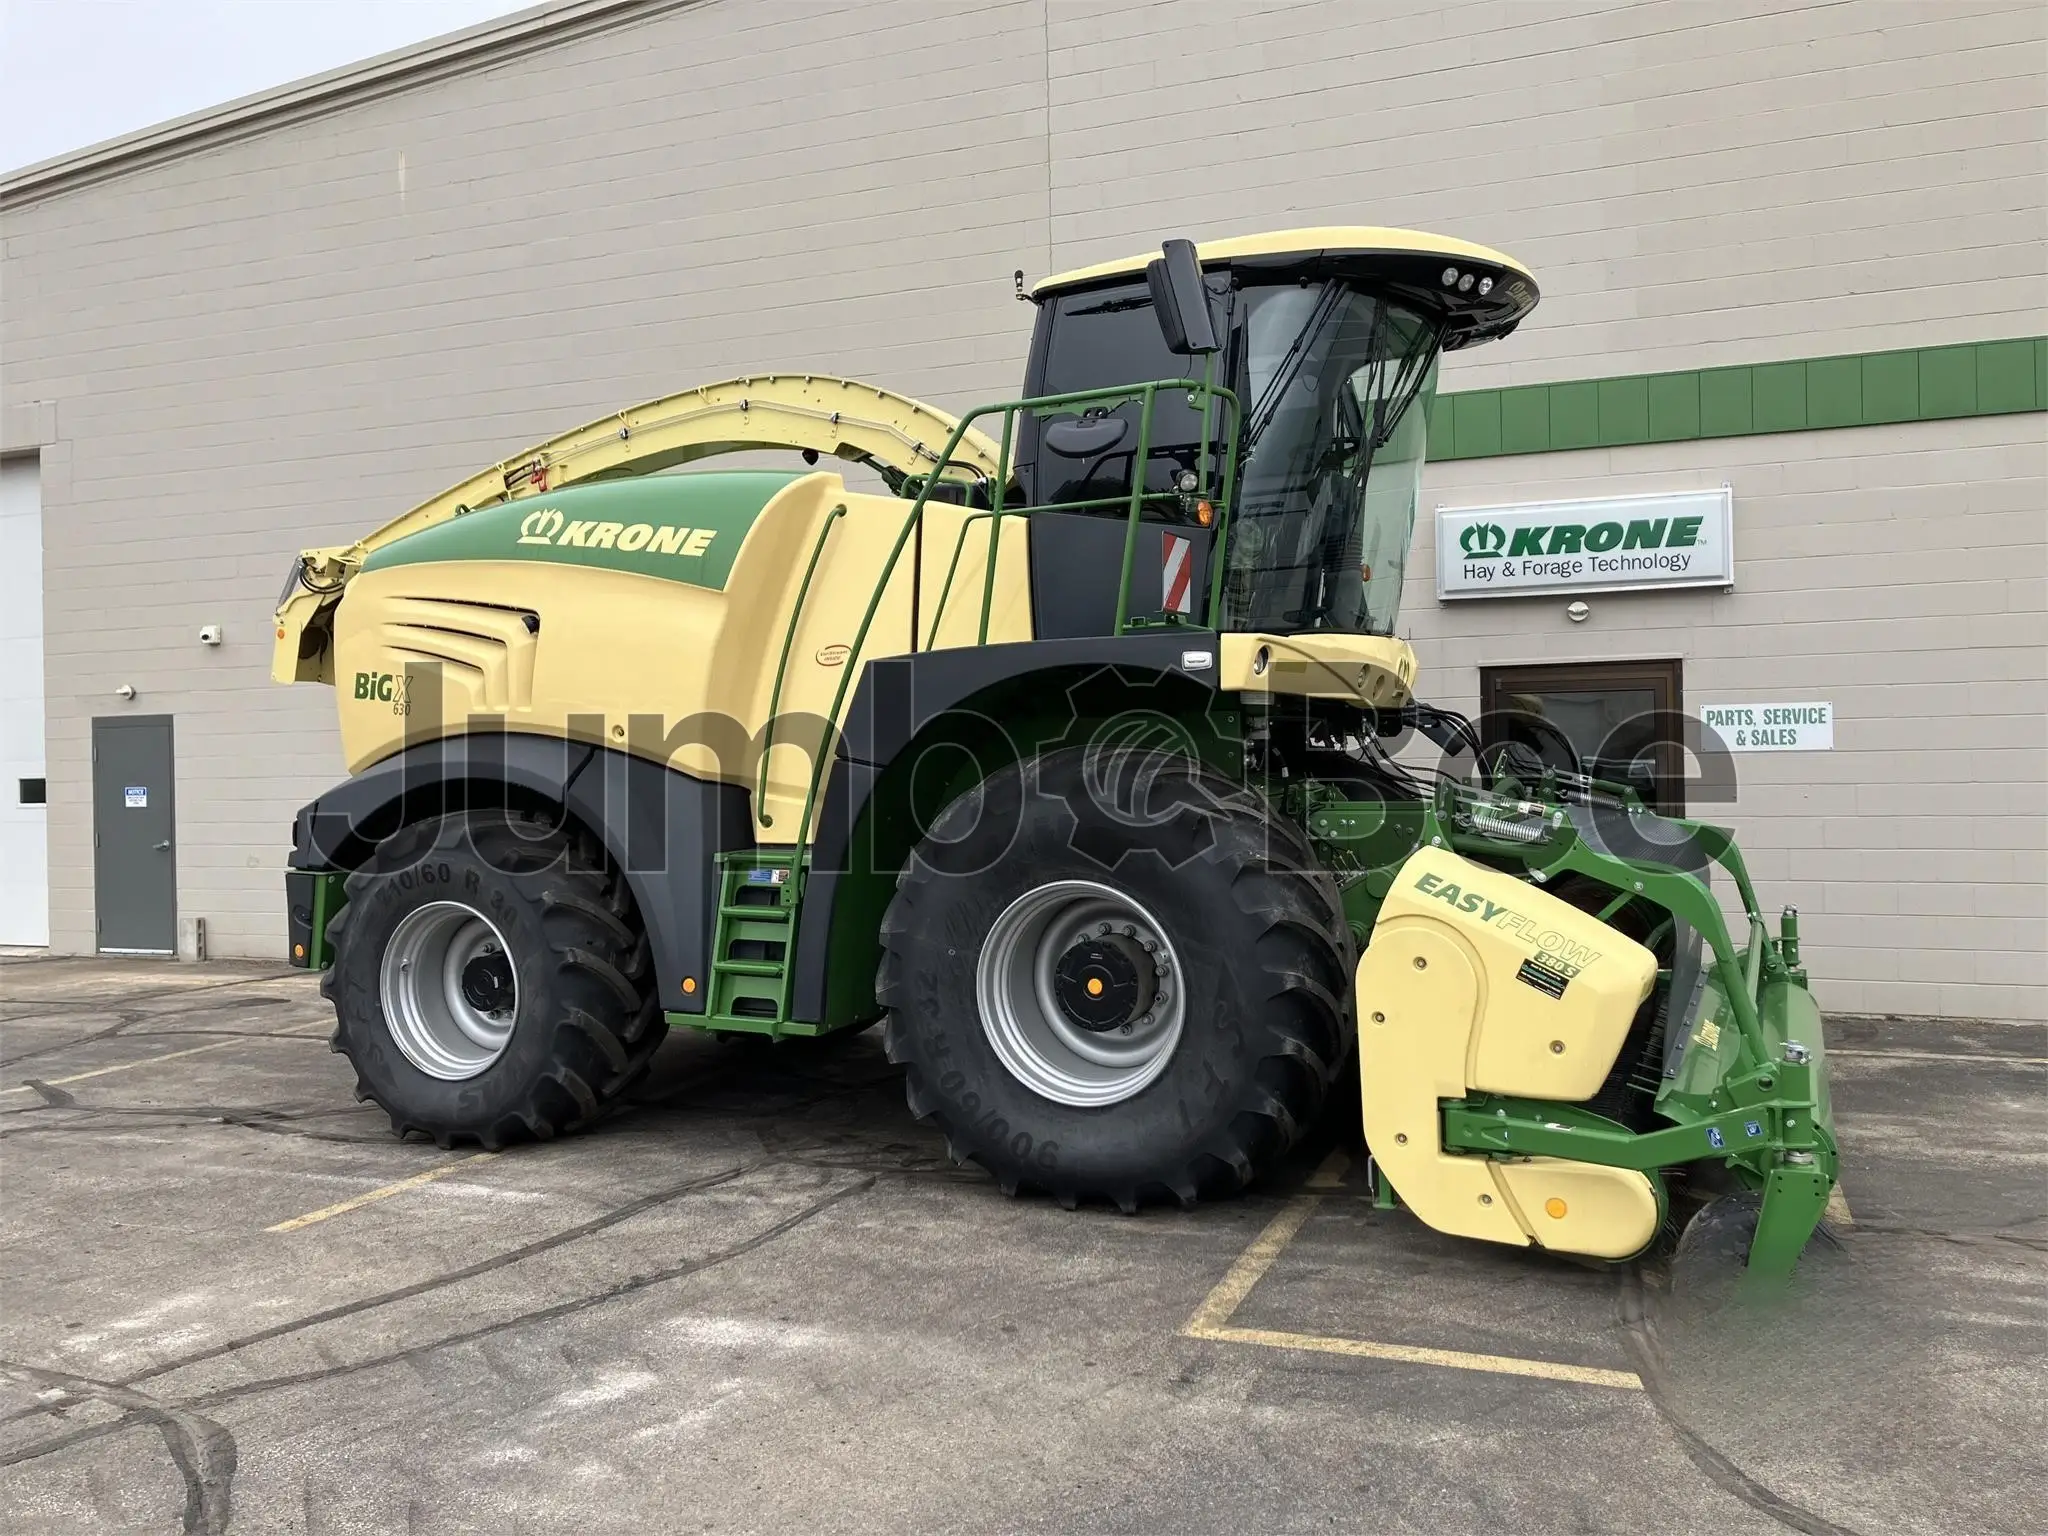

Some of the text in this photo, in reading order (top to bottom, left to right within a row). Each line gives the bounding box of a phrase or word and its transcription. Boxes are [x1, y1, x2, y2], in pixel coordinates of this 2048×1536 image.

[556, 520, 718, 557] KRONE
[1507, 516, 1704, 557] KRONE
[1463, 553, 1691, 581] Hay & Forage Technology
[393, 702, 411, 716] 630
[1706, 707, 1827, 727] PARTS, SERVICE
[1736, 728, 1797, 746] & SALES
[1537, 952, 1577, 977] 380 S
